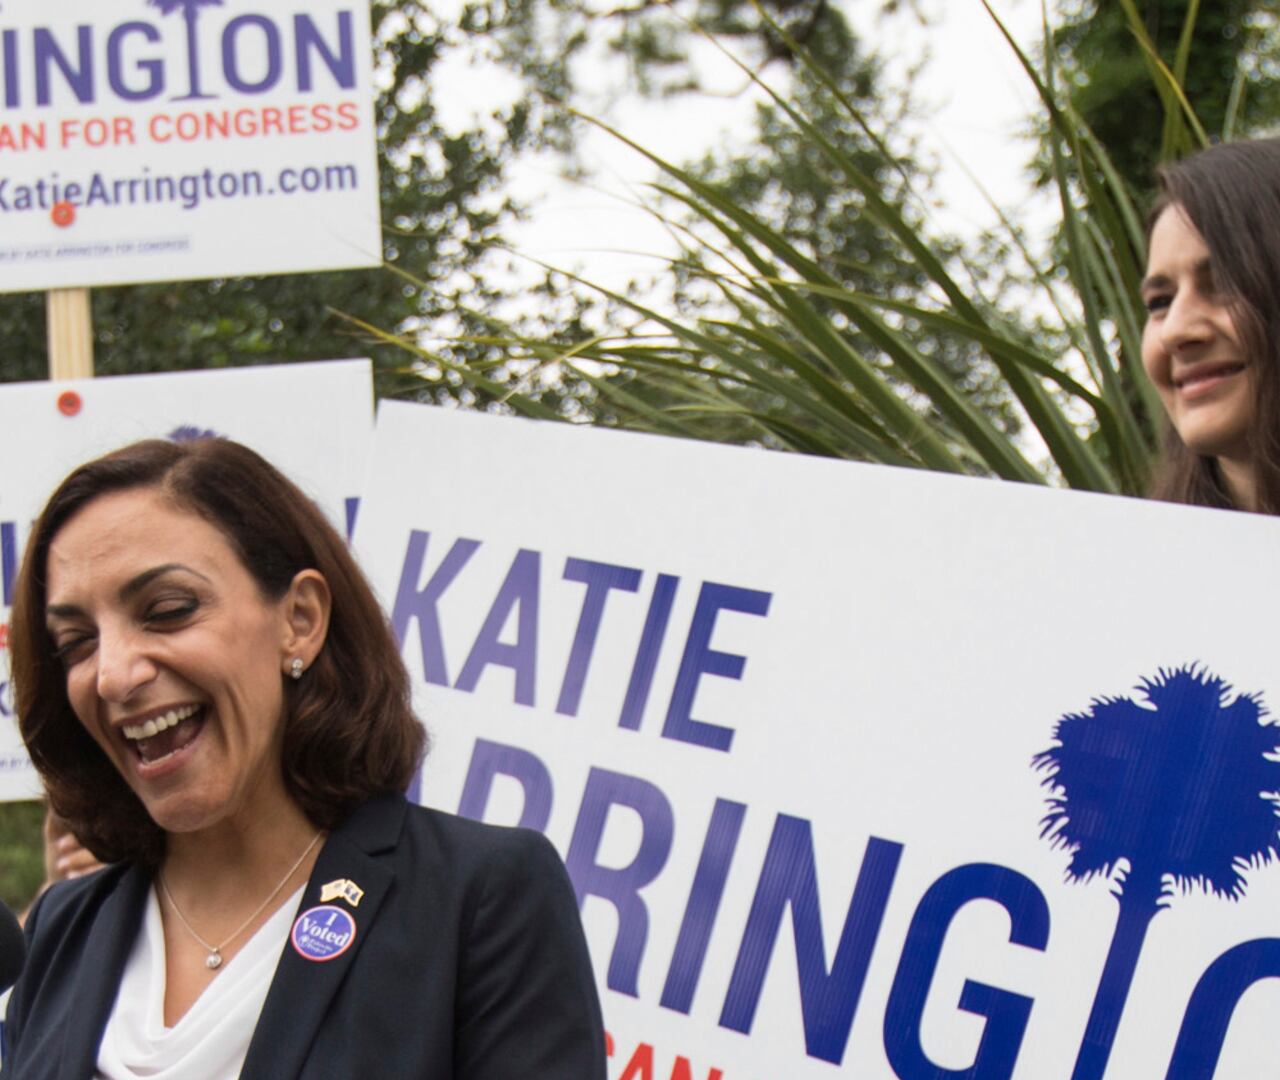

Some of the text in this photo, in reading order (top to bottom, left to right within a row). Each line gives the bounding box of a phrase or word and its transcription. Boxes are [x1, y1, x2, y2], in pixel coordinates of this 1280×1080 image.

[61, 117, 137, 150] FOR
[149, 101, 360, 142] CONGRESS
[391, 528, 773, 753] KATIE
[301, 916, 350, 948] Voted
[325, 912, 339, 927] I
